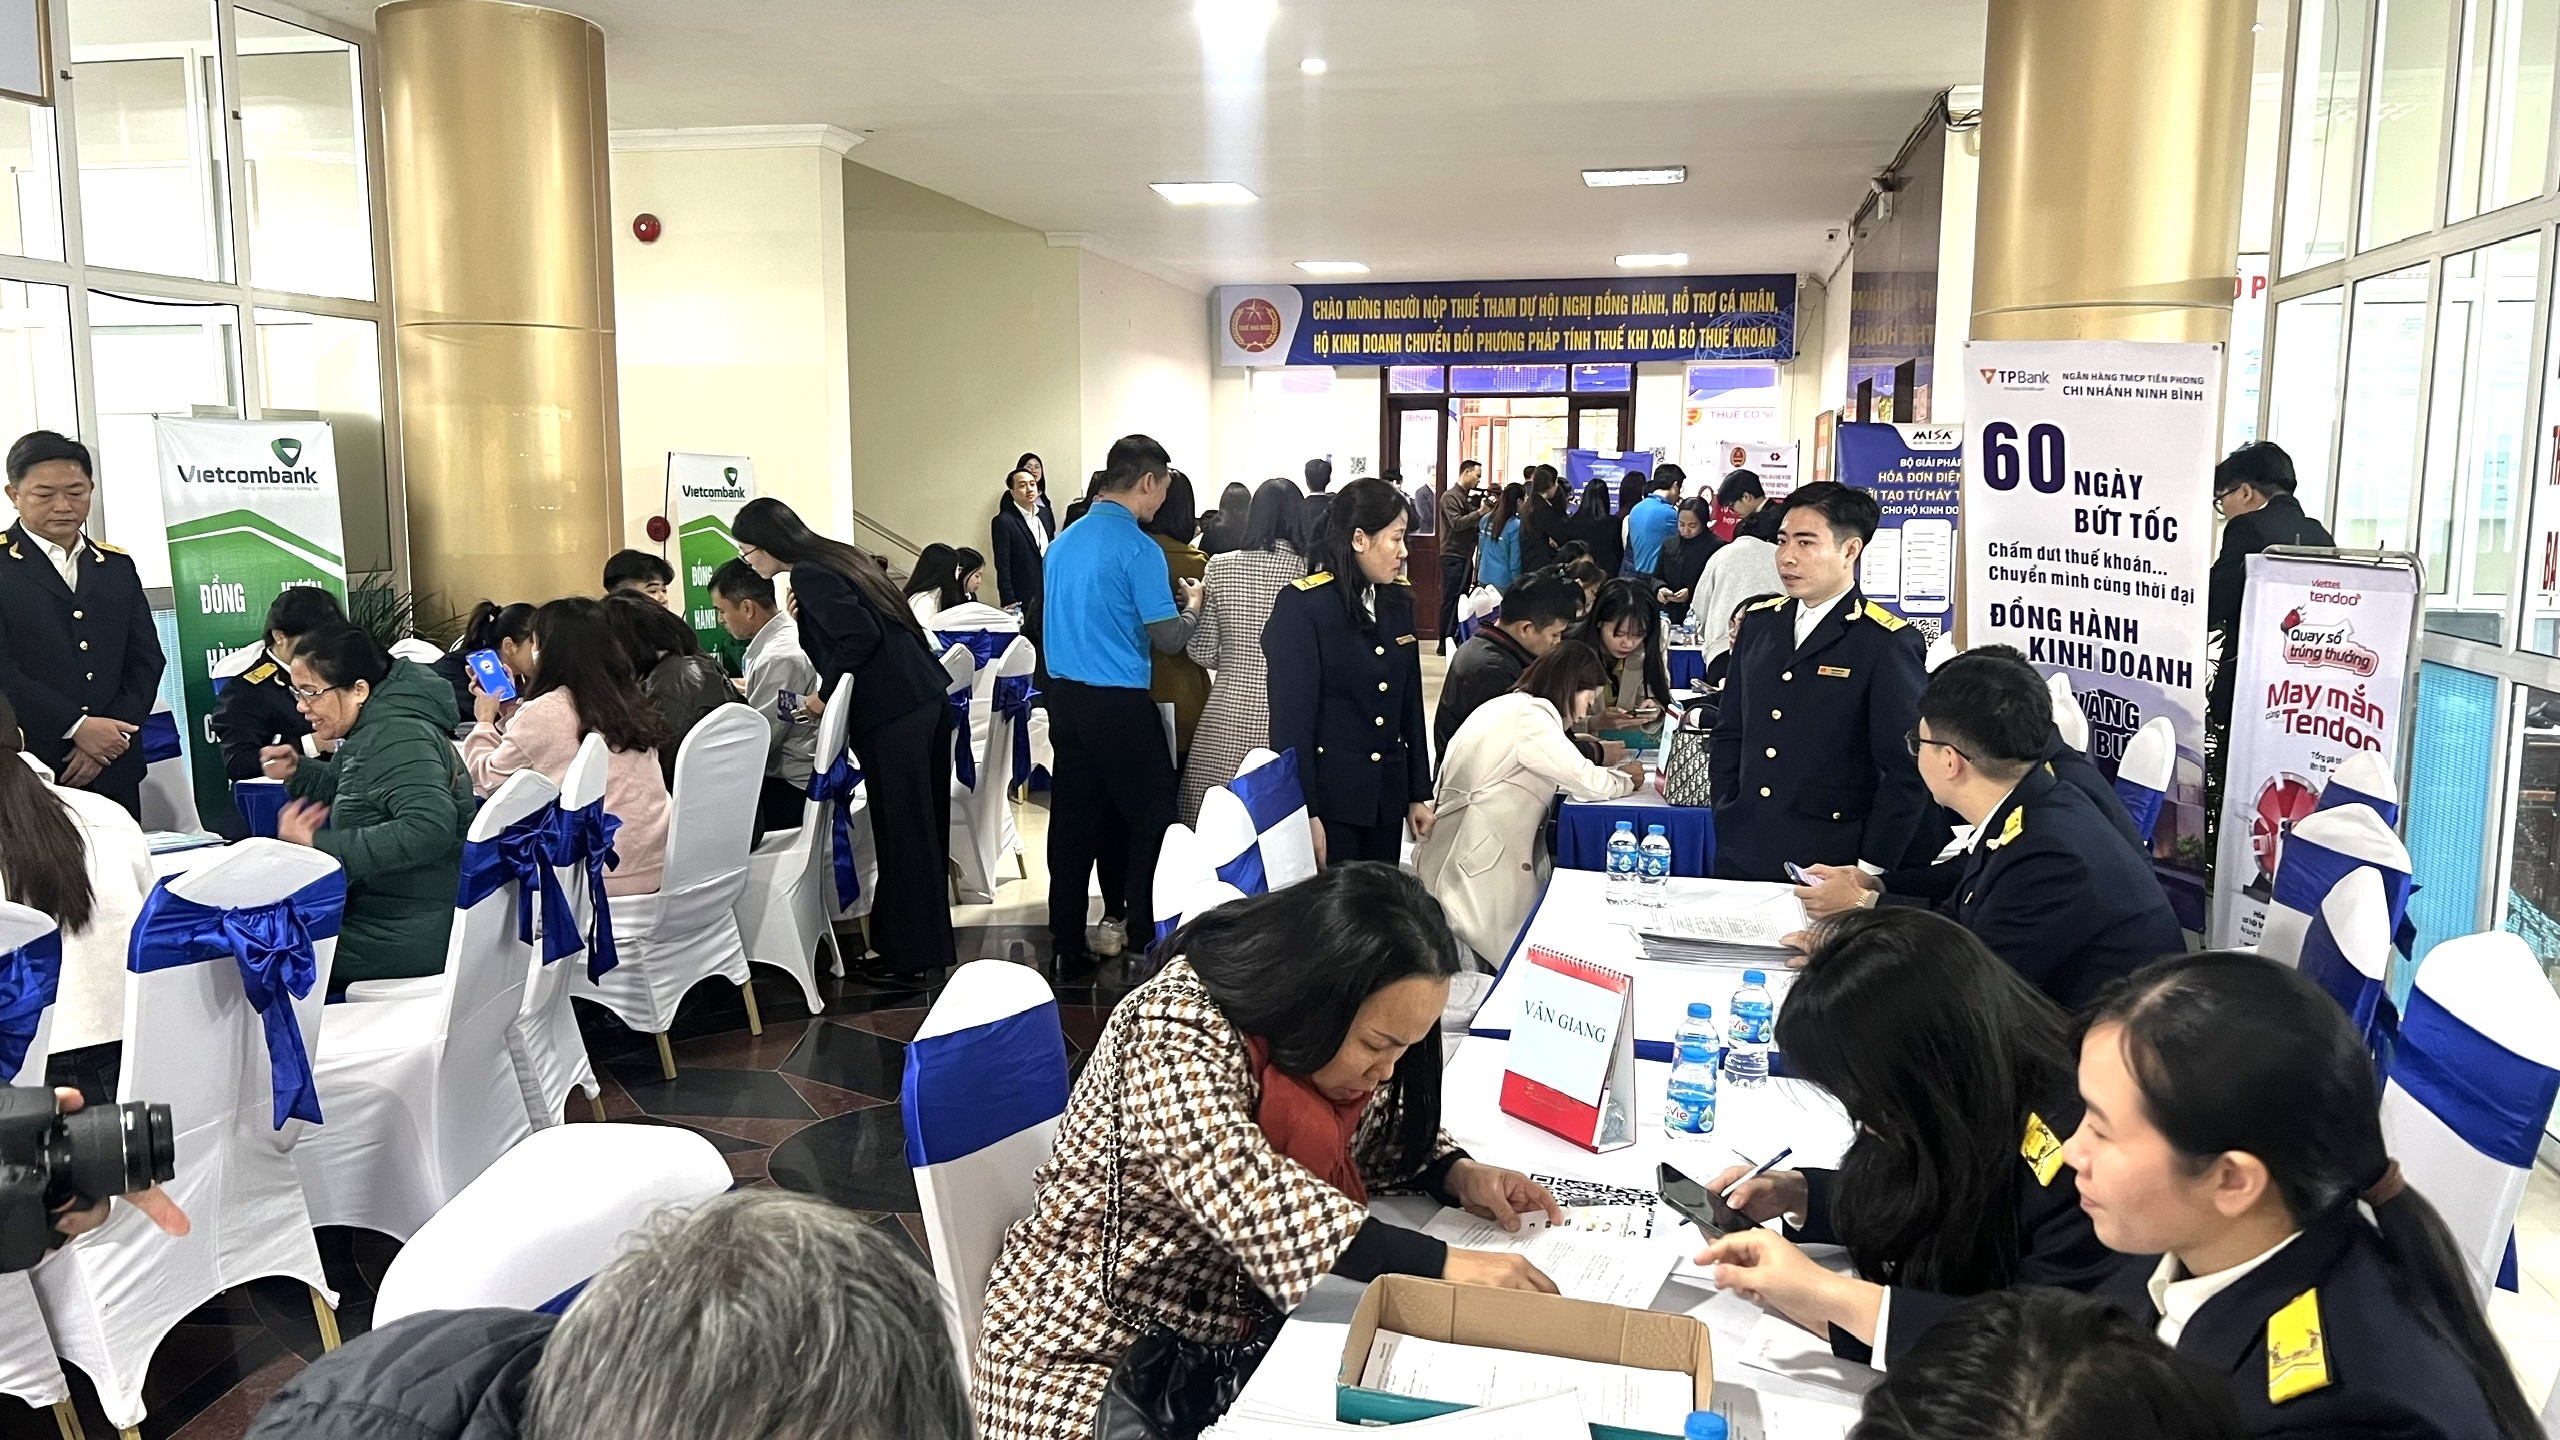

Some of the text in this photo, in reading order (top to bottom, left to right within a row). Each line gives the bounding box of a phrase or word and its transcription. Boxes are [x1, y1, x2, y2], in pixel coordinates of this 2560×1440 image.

[1313, 286, 1779, 323] CHÀO MỪNG NGƯỜI NỘP THUẾ THAM DỰ HỘI NGHỊ ĐỒNG HÀNH, HỖ TRỢ CÁ NHÂN,
[1313, 321, 1777, 358] HỘ KINH DOANH CHUYỂN ĐỔI PHƯƠNG PHÁP TÍNH THUẾ KHI XOÁ BỎ THUẾ KHOÁN
[1998, 370, 2050, 385] TPBank
[2062, 371, 2089, 381] NGÂN
[2091, 372, 2118, 382] HÀNG
[2120, 373, 2145, 383] TMCP
[2170, 375, 2205, 385] PHONG
[2062, 384, 2203, 401] CHI NHÁNH NINH BÌNH
[1912, 429, 1952, 440] MISA
[1900, 457, 1914, 469] BỘ
[1983, 421, 2066, 494] 60
[177, 465, 318, 484] Vietcombank
[1878, 470, 1904, 483] HÓA
[1907, 471, 1933, 483] ĐƠN
[2074, 467, 2143, 501] NGÀY
[682, 485, 745, 498] Vietcombank
[1881, 490, 1904, 503] TẠO
[1907, 488, 1925, 500] TỪ
[1926, 488, 1952, 500] MÁY
[1881, 505, 1902, 515] CHO
[1904, 504, 1918, 516] HỘ
[1920, 505, 1944, 515] KINH
[2074, 505, 2178, 543] BỨT TỐC
[1989, 541, 2032, 560] Chấm
[2065, 548, 2101, 567] thuế
[2103, 551, 2168, 576] khoán...
[1989, 563, 2195, 606] Chuyển mình cùng thời đại
[2310, 590, 2359, 606] tendoo
[694, 605, 717, 630] HÀNH
[1990, 596, 2139, 645] ĐỒNG HÀNH
[2290, 629, 2345, 645] Quay số
[2029, 636, 2193, 690] KINH DOANH
[2290, 644, 2370, 670] trúng thưởng
[2266, 680, 2384, 730] May mắn
[1525, 1000, 1606, 1043] VÂN GIANG
